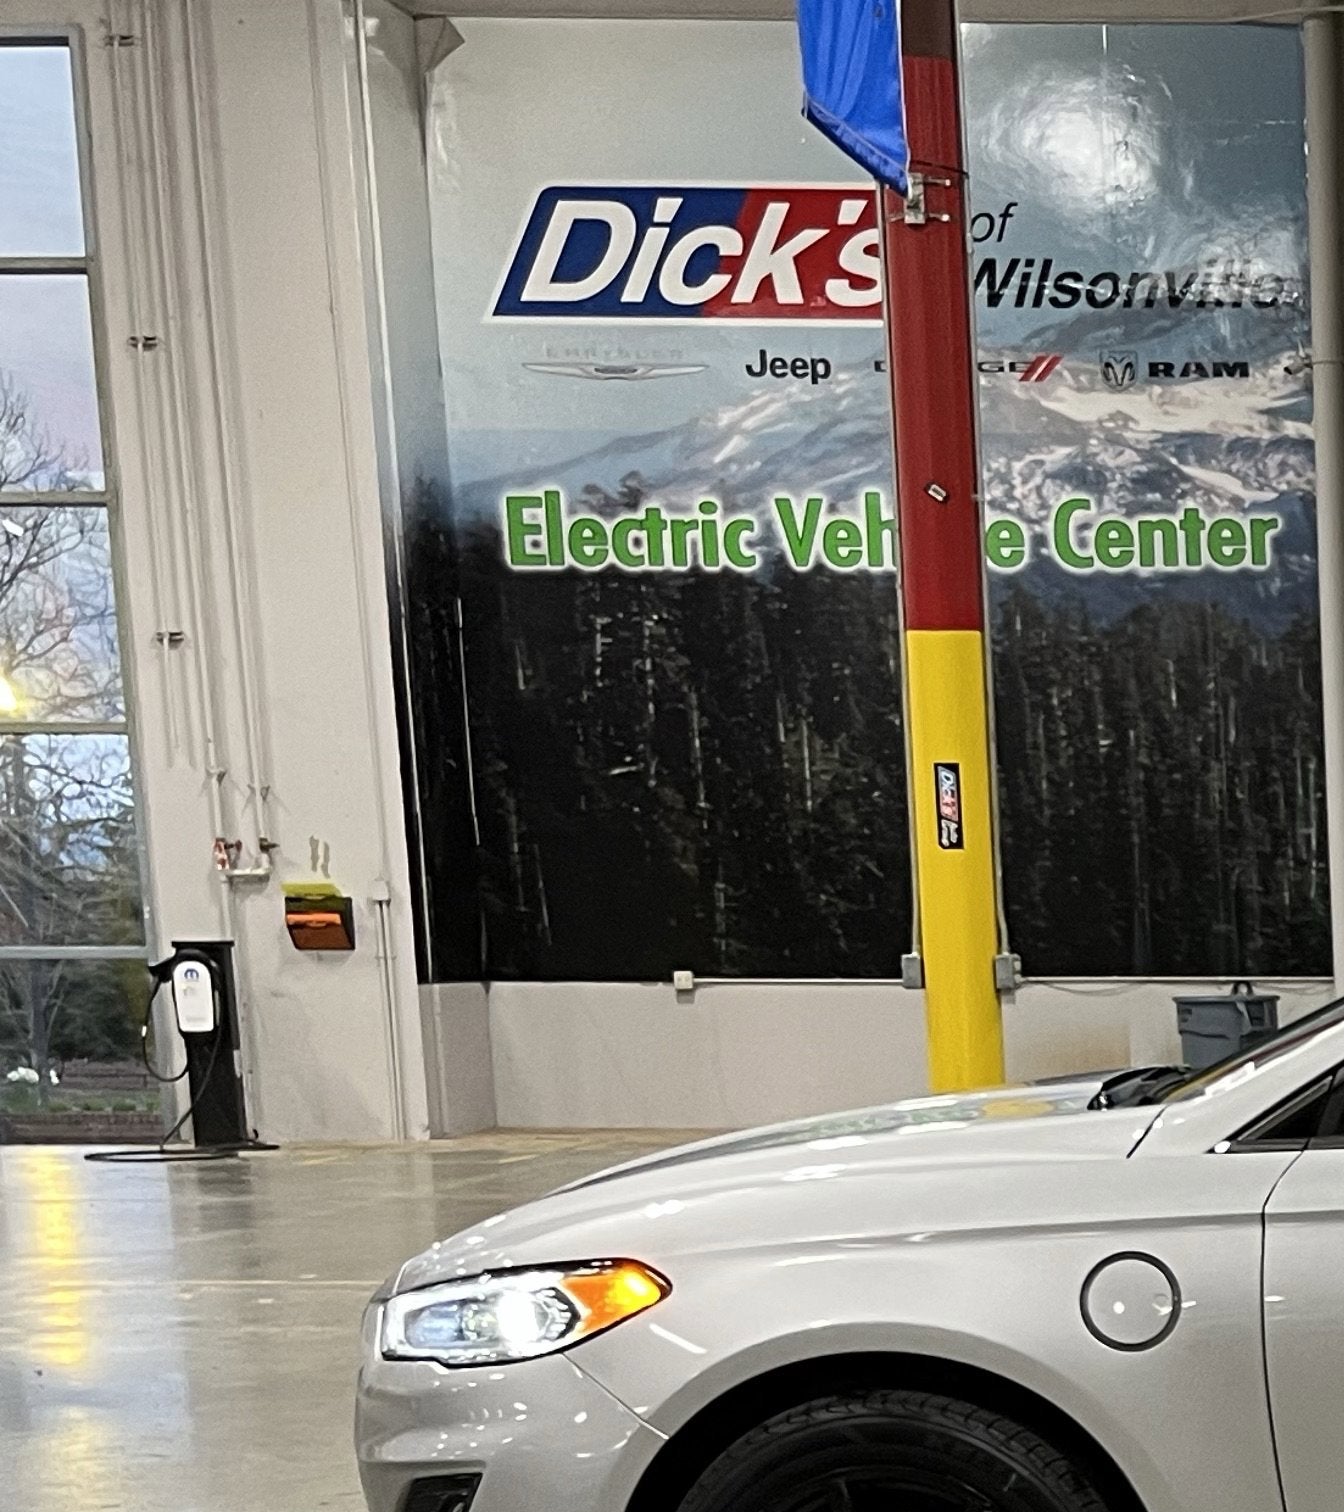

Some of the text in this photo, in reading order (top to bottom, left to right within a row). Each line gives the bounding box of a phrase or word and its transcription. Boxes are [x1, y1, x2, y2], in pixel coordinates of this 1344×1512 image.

[971, 203, 1018, 243] of
[745, 349, 832, 384] Jeep
[1148, 361, 1250, 379] RAM
[505, 489, 1279, 569] Electric Vehe Center
